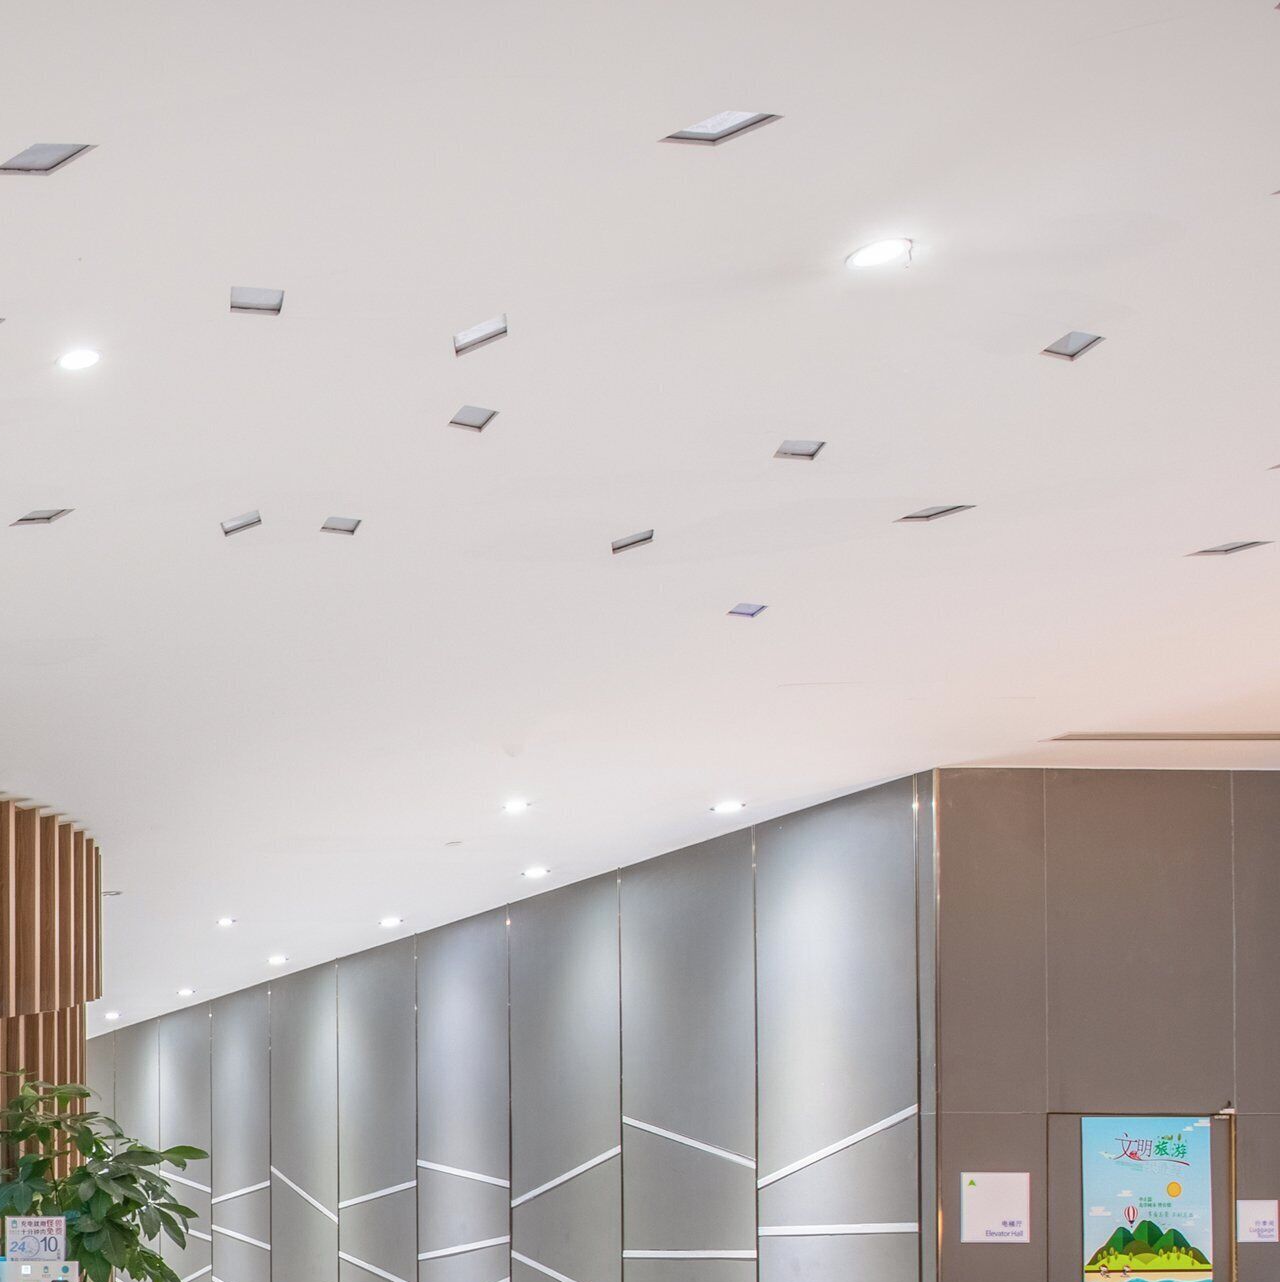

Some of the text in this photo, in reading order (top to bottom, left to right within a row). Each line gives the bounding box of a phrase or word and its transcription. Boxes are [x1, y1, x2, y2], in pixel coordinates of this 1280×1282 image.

[1114, 1132, 1187, 1160] 文明旅游
[10, 1241, 26, 1252] 24
[40, 1236, 58, 1252] 10
